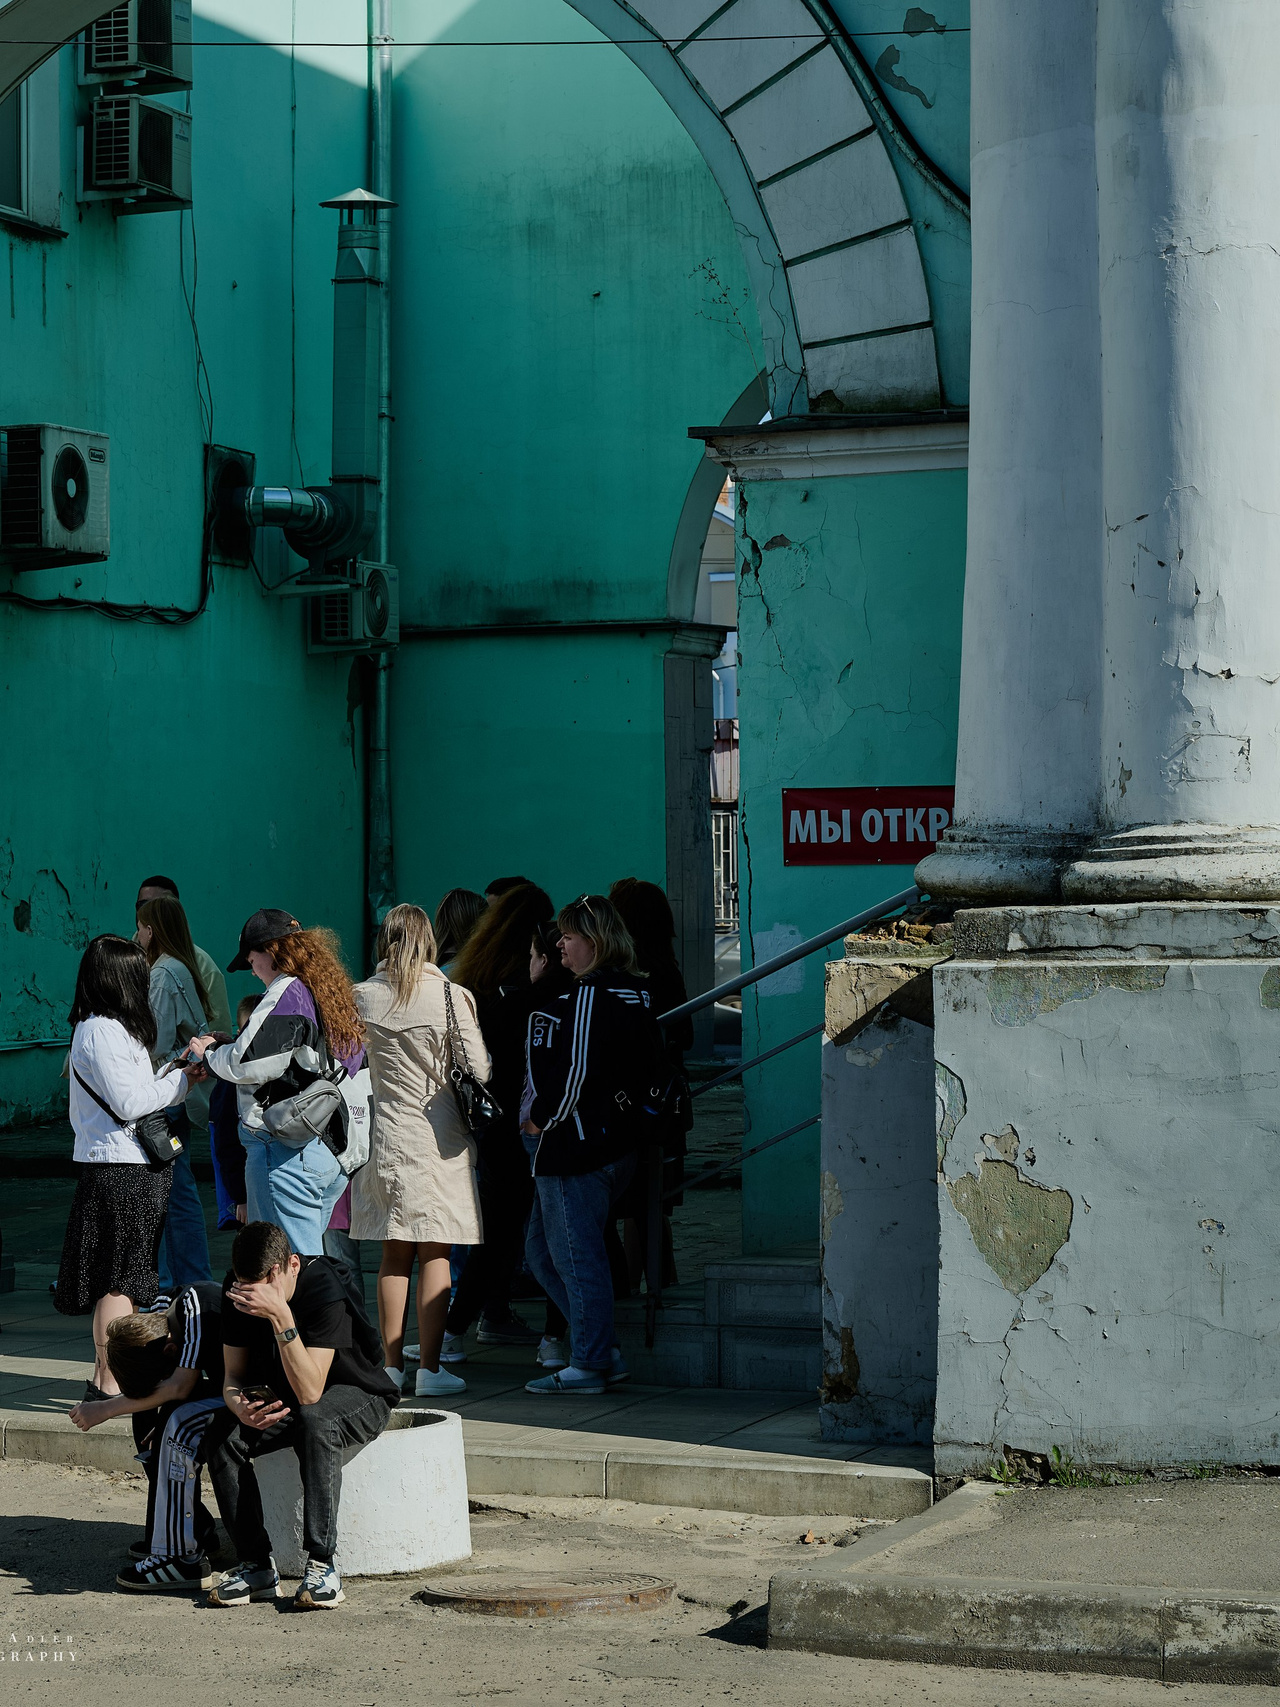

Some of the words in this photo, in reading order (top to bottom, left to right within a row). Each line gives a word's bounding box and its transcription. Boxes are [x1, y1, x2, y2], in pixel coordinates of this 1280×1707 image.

[788, 809, 851, 844] МЫ
[860, 806, 955, 843] ОТКР
[532, 1015, 549, 1047] das
[168, 1439, 193, 1456] adidas
